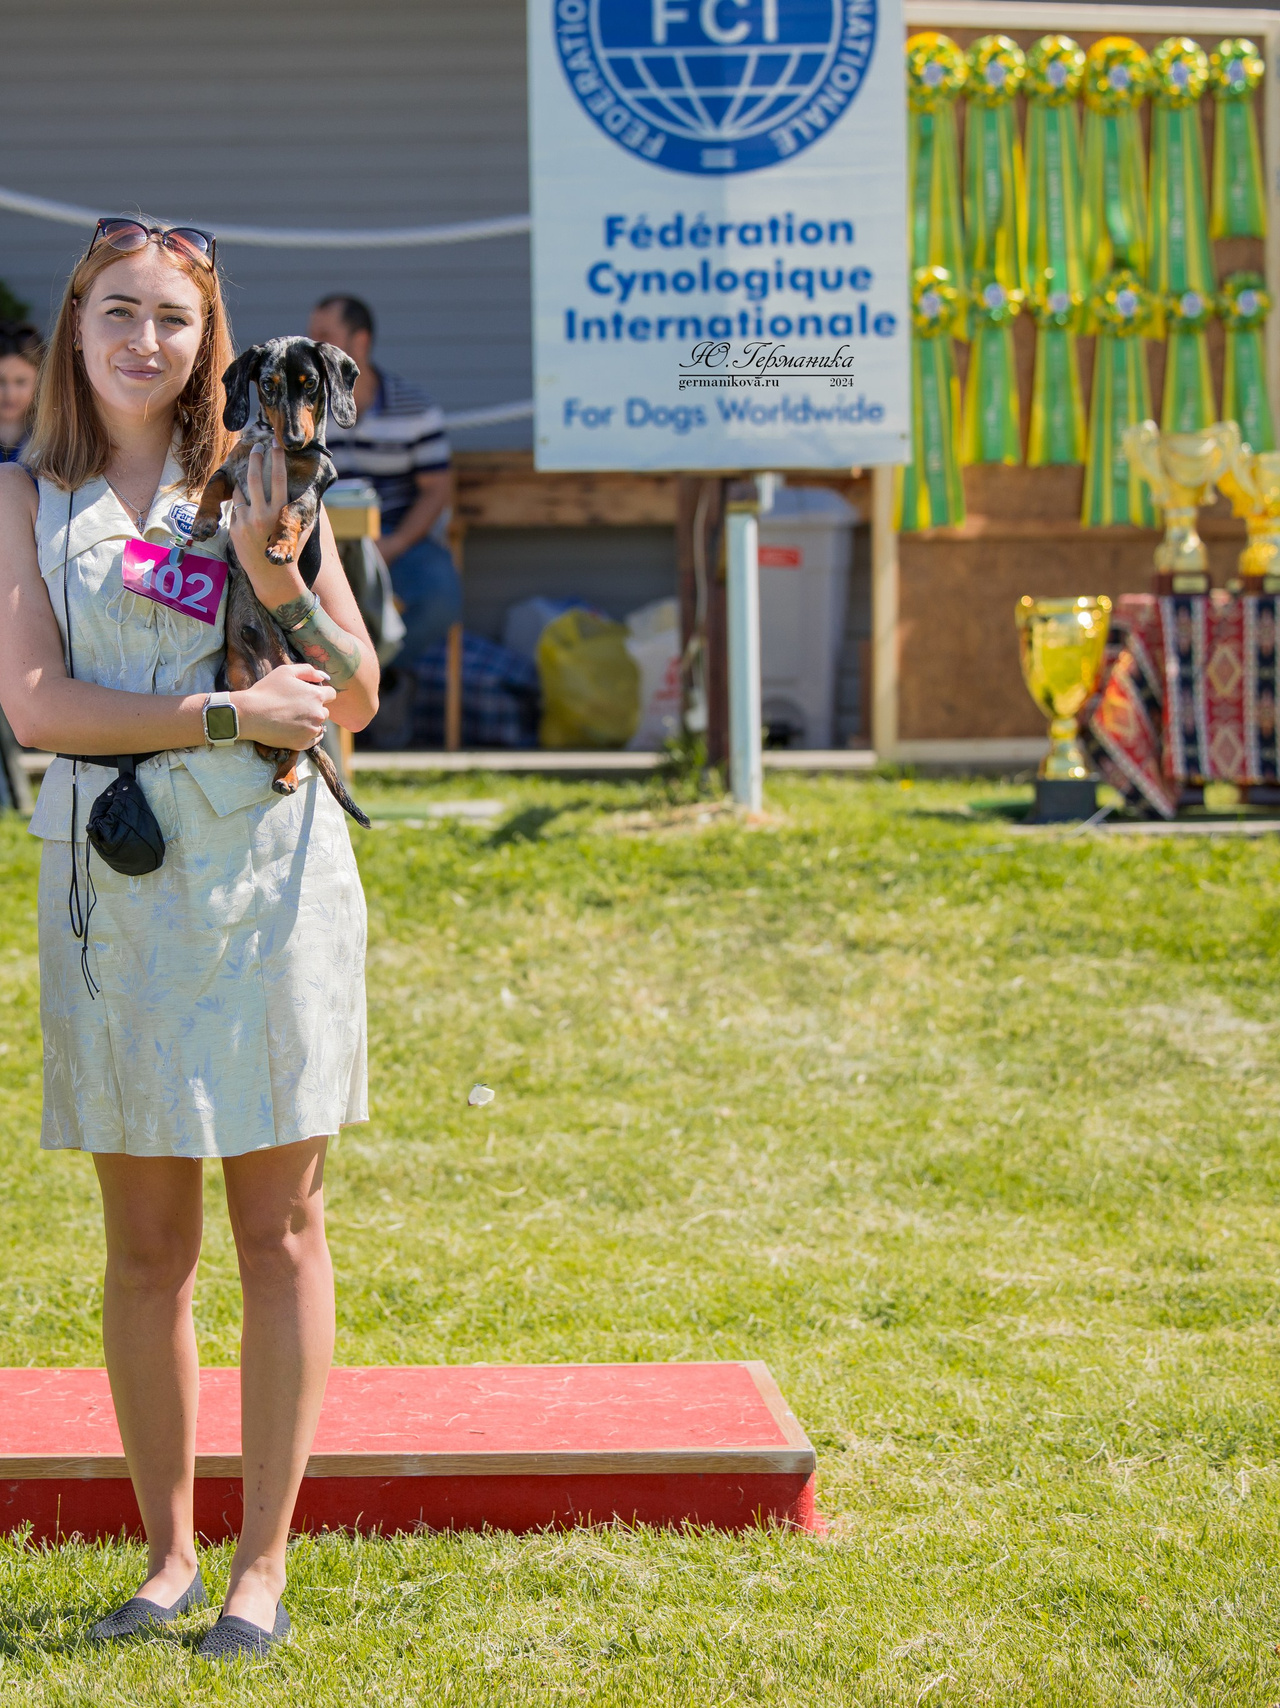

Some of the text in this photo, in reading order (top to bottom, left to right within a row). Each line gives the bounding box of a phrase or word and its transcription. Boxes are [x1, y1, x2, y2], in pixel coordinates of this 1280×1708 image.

[651, 0, 779, 45] FCI
[604, 212, 854, 249] Fédération
[586, 259, 874, 301] Cynologique
[564, 303, 897, 342] Internationale
[563, 393, 886, 435] For Dogs Worldwide
[134, 558, 214, 614] 102
